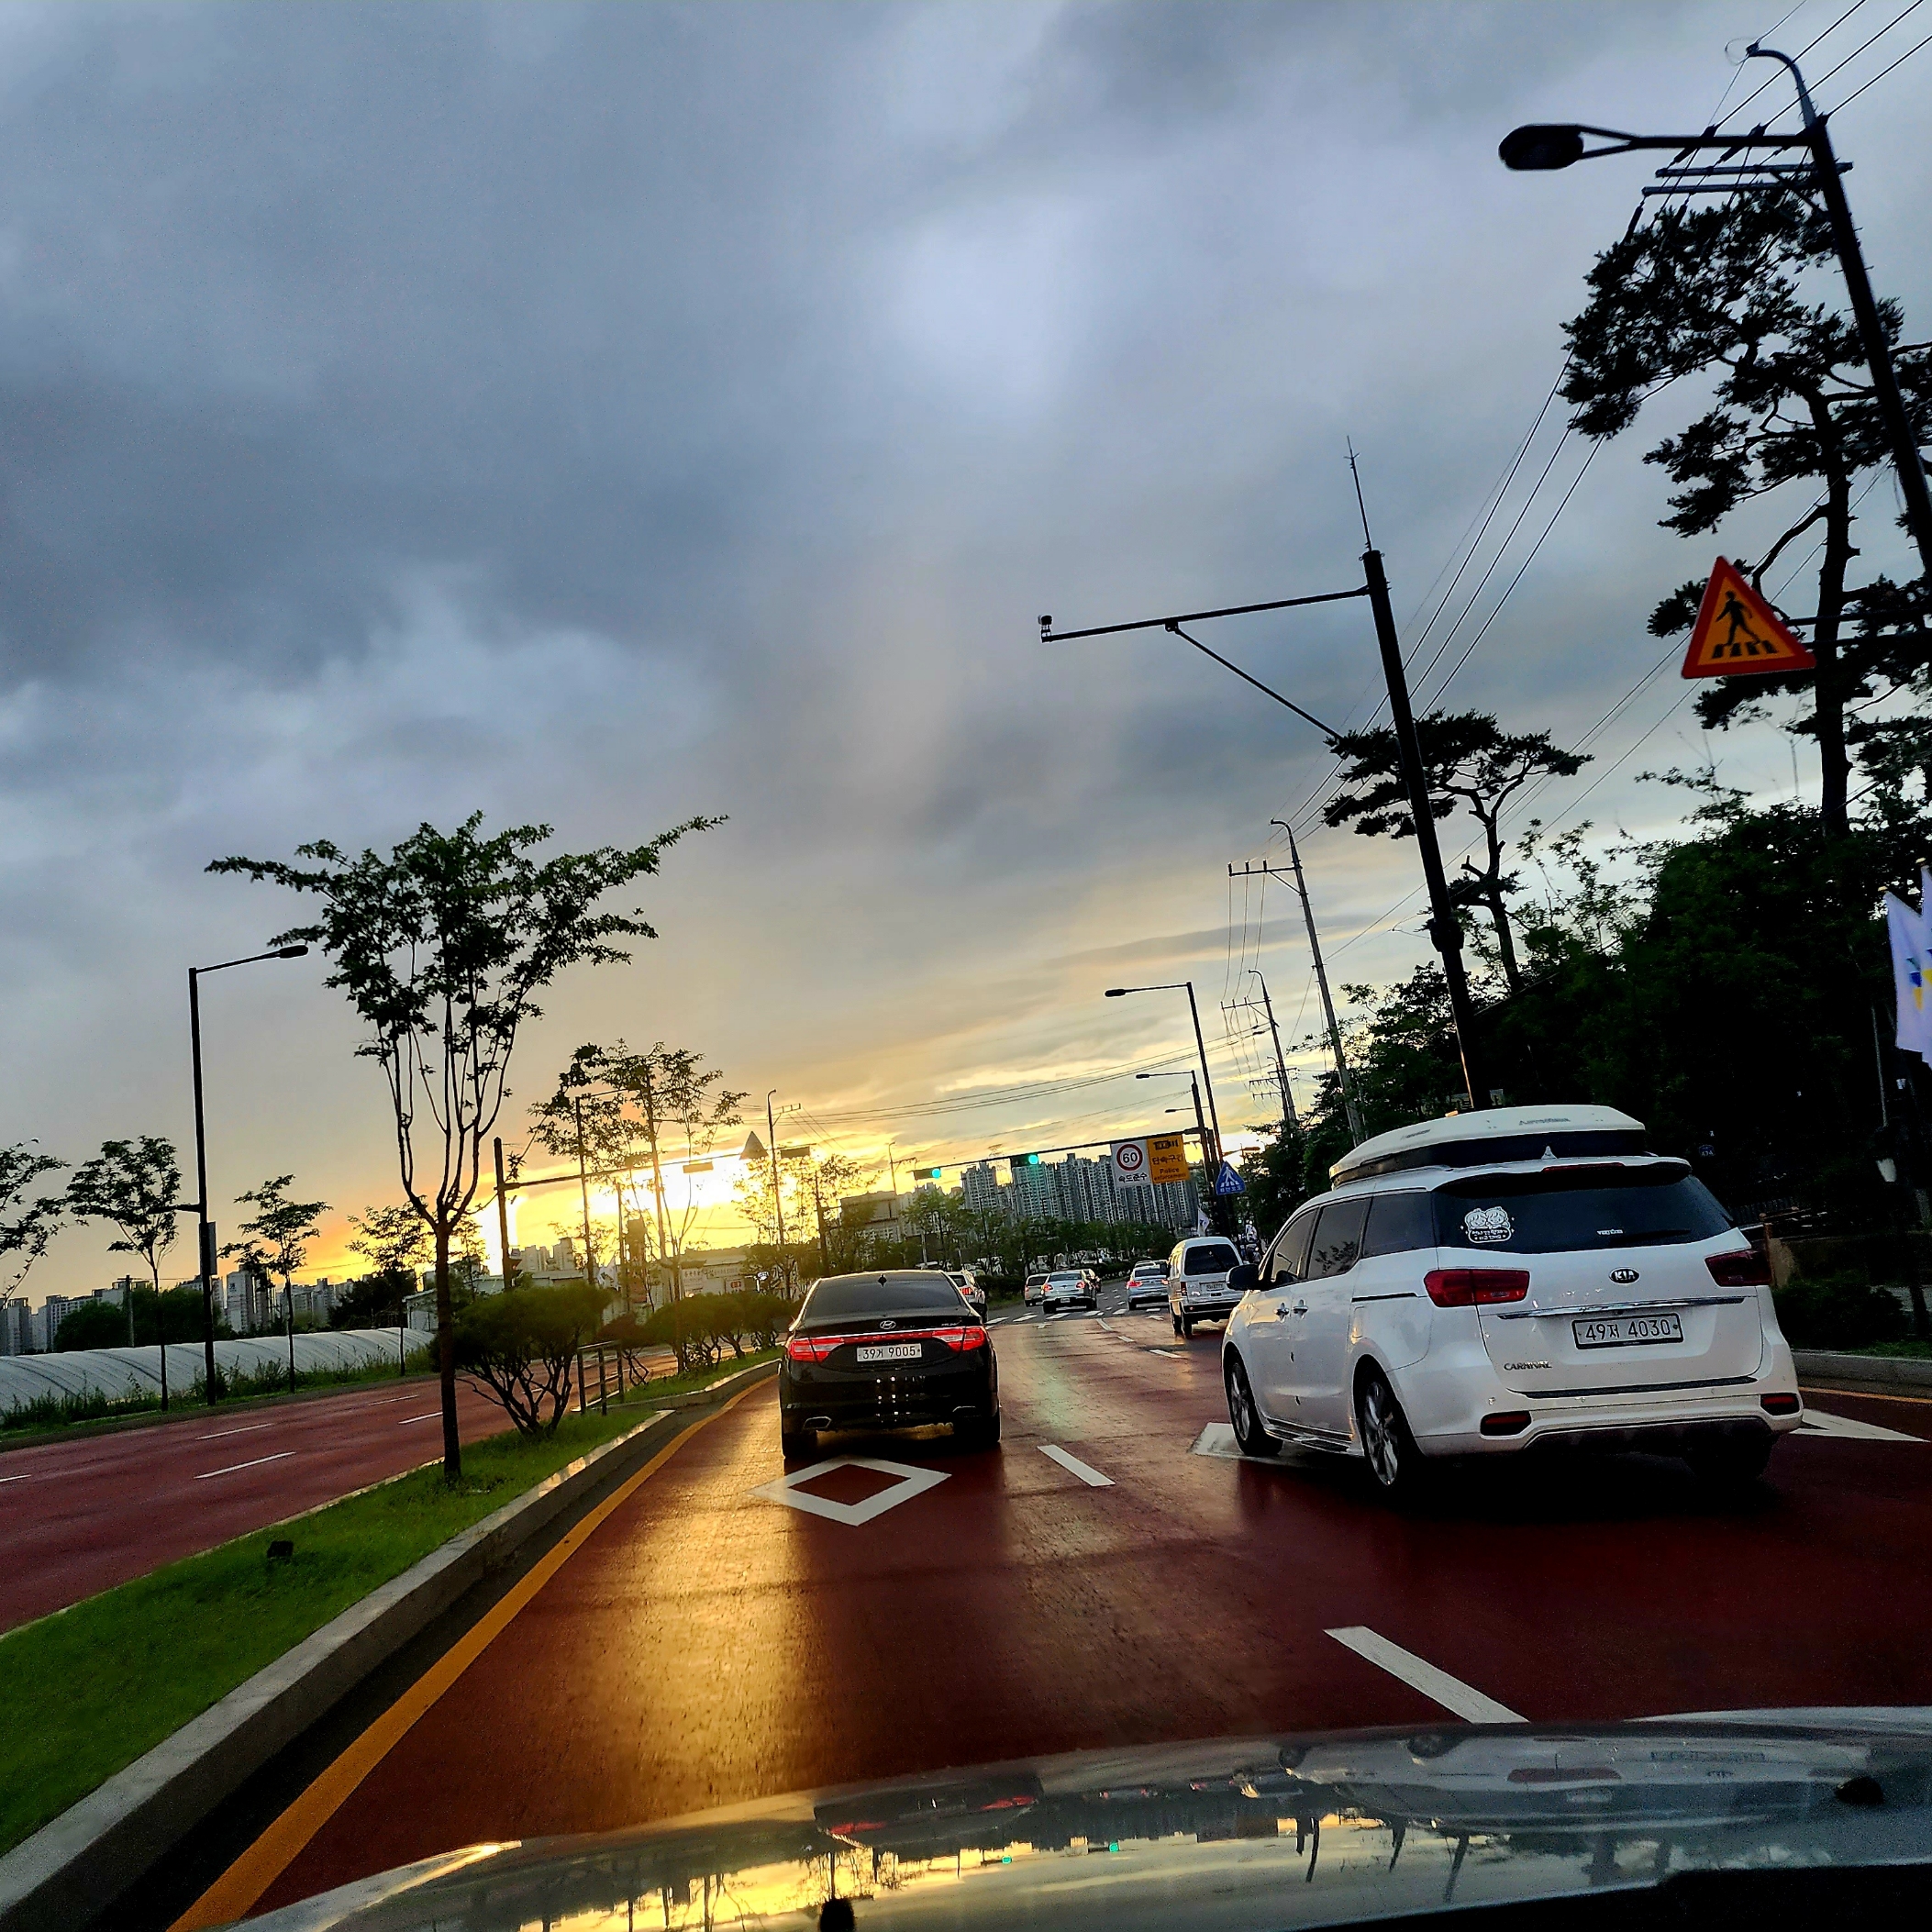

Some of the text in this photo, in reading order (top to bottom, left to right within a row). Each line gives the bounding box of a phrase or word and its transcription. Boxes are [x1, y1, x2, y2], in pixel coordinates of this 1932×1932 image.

[1122, 1152, 1138, 1163] 60
[1152, 1152, 1184, 1165] 단속구간
[1118, 1171, 1148, 1183] 속도준수
[1614, 1271, 1636, 1281] KIA
[1585, 1319, 1671, 1340] 49저 4030
[863, 1346, 916, 1360] 39거 9005
[1504, 1360, 1552, 1371] CARNIVAL
